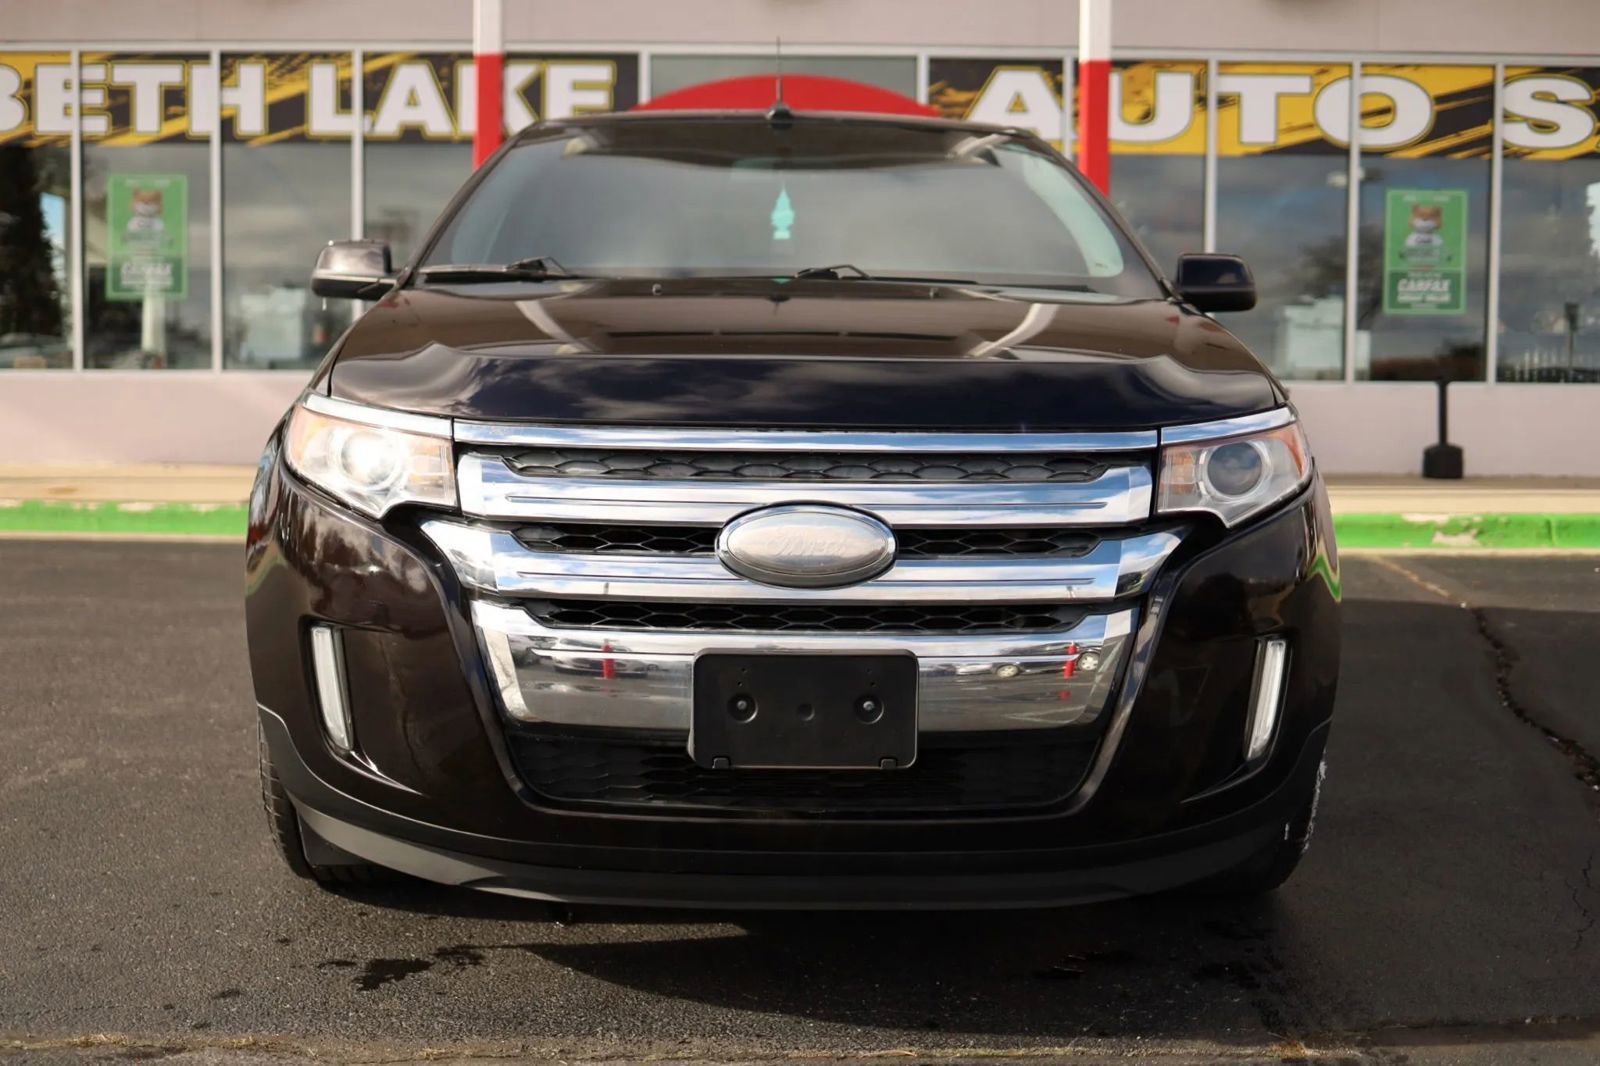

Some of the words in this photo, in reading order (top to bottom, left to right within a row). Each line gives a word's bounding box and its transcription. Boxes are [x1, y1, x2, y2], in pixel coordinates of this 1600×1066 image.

[307, 61, 614, 138] LAKE
[965, 68, 1433, 147] AUTO
[1502, 74, 1600, 149] S
